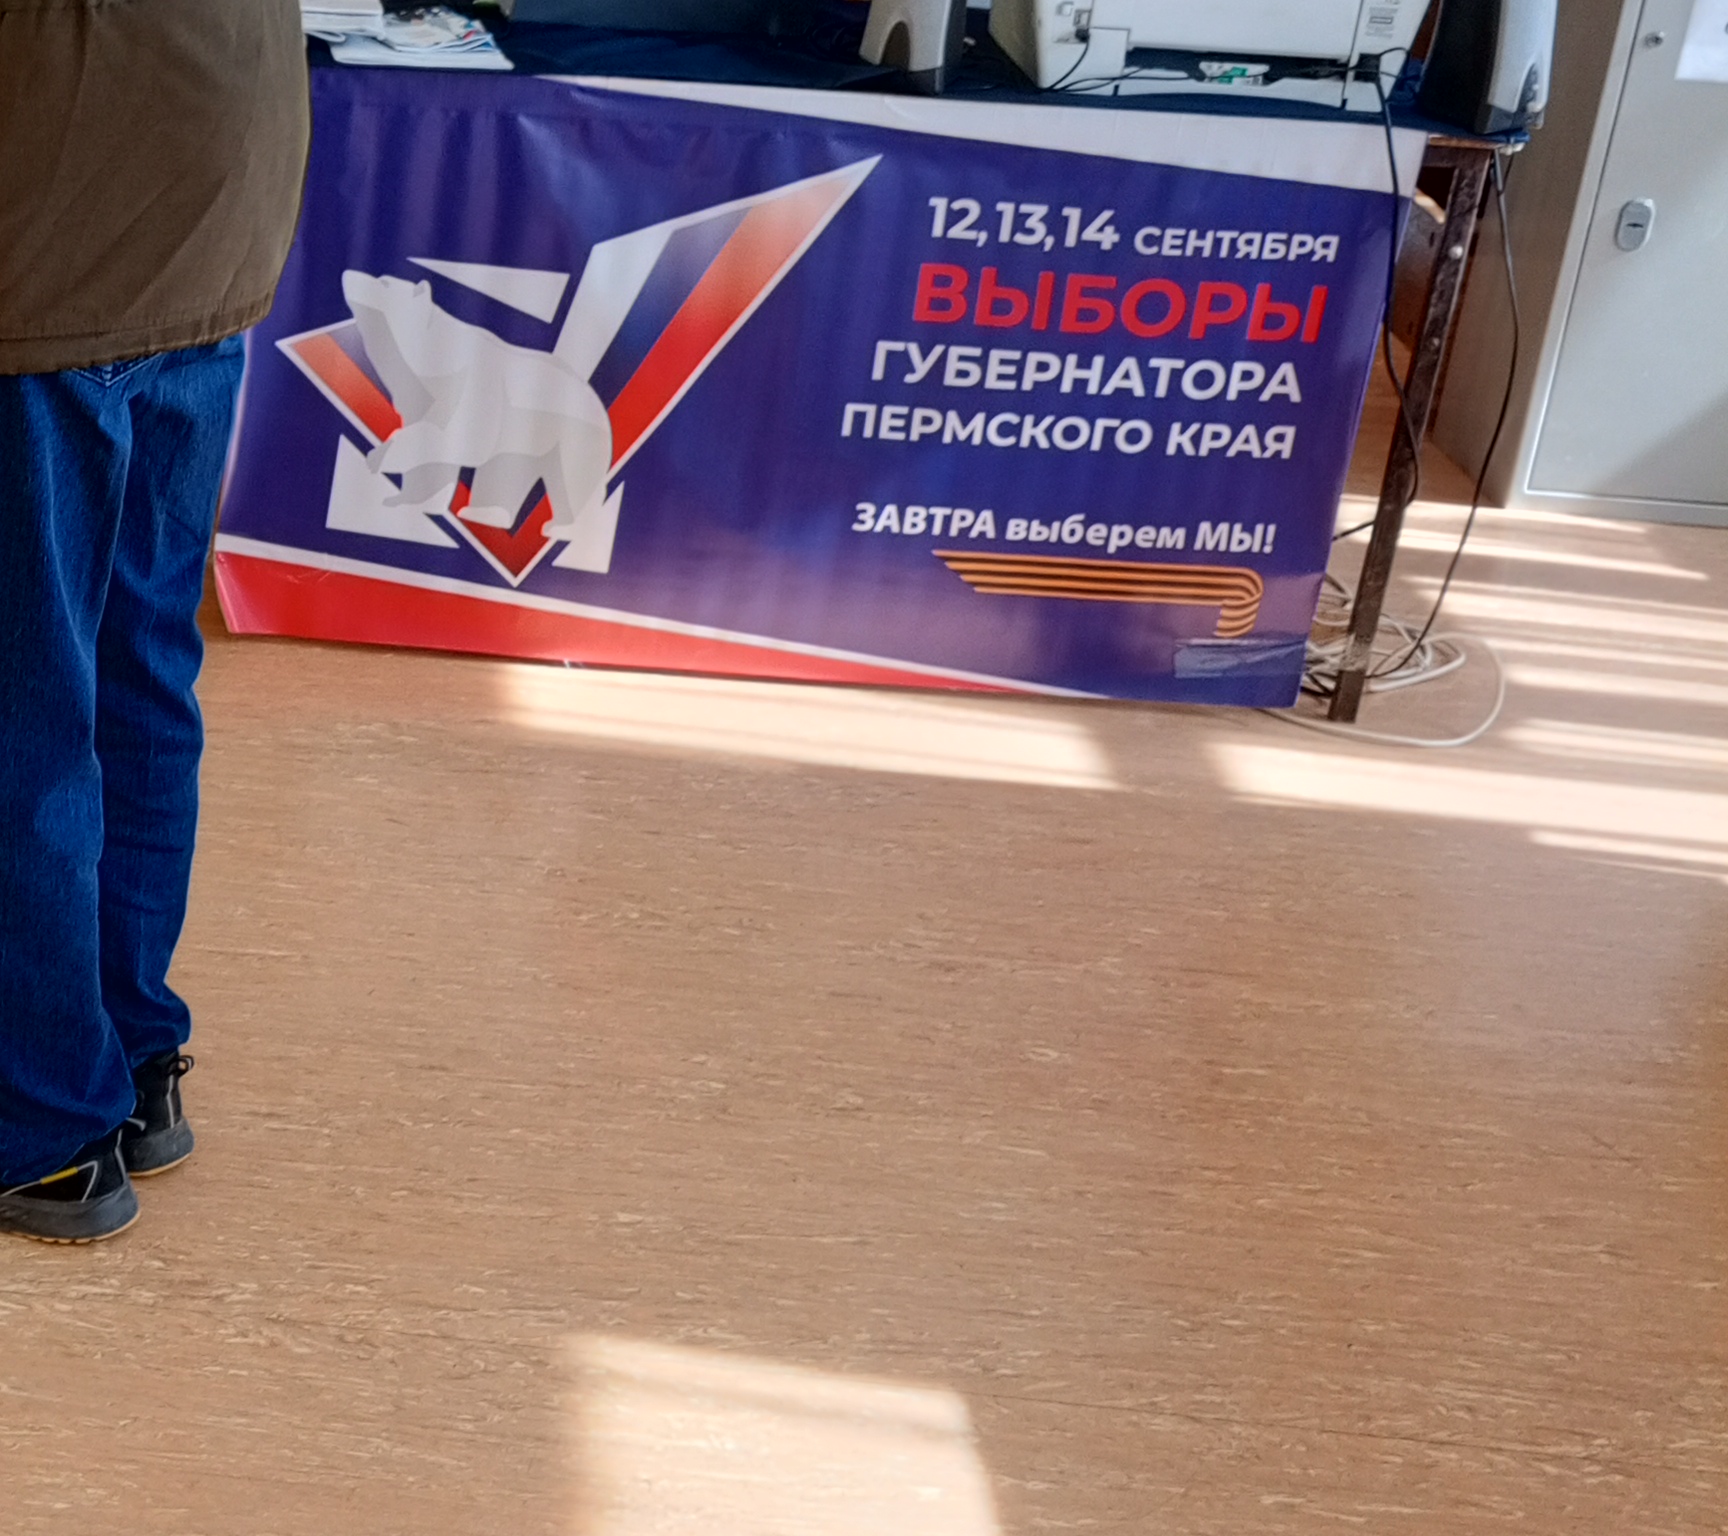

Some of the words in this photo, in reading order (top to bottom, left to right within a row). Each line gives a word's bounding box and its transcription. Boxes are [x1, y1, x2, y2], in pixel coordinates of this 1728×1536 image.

[927, 196, 1121, 252] 12,13,14
[1134, 226, 1340, 263] СЕНТЯБРЯ
[912, 262, 1327, 343] ВЫБОРЫ
[871, 340, 1302, 403] ГУБЕРНАТОРА
[840, 402, 1153, 455] ПЕРМСКОГО
[1166, 421, 1296, 460] КРАЯ
[852, 502, 996, 539] ЗАВТРА
[1005, 514, 1186, 554] выберем
[1194, 520, 1276, 554] МЫ!
